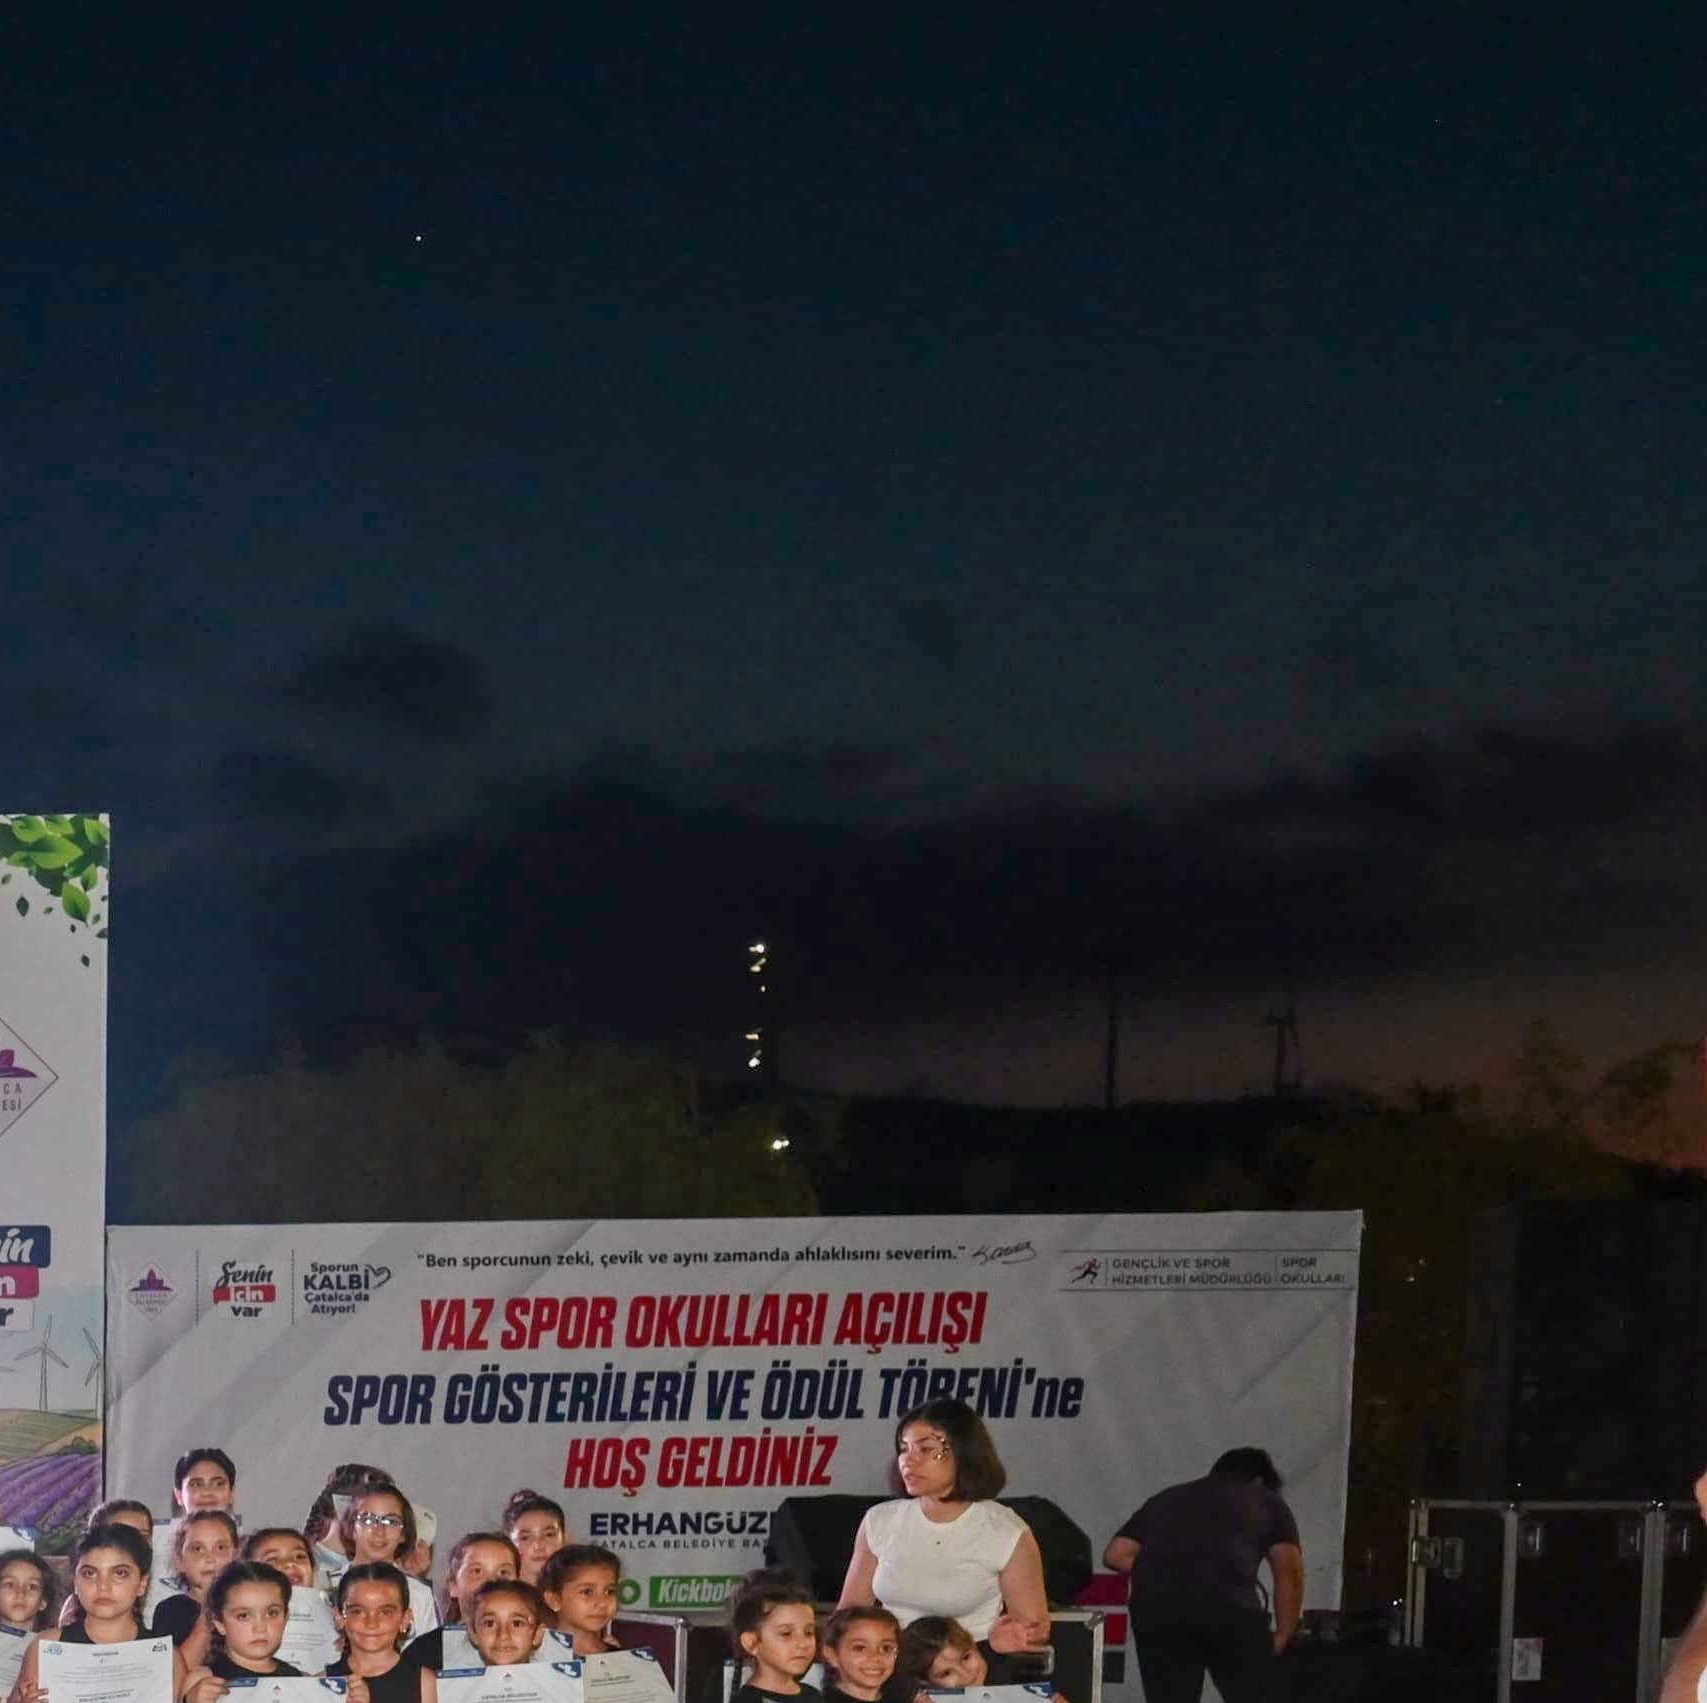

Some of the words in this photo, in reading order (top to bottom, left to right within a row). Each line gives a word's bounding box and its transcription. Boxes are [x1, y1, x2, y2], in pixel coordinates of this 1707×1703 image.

[462, 1252, 552, 1269] sporcunun
[556, 1250, 594, 1268] zeki,
[600, 1250, 642, 1268] çevik
[648, 1253, 668, 1266] ve
[673, 1252, 709, 1268] aynı
[713, 1248, 790, 1265] zamanda
[794, 1247, 881, 1264] ahlaklısını
[1111, 1256, 1170, 1270] GENÇLİK
[1174, 1257, 1191, 1269] VE
[1194, 1257, 1232, 1269] SPOR
[1281, 1257, 1318, 1269] SPOR
[215, 1258, 275, 1289] Senin
[310, 1261, 359, 1275] Sporun
[303, 1268, 370, 1291] KALBİ
[1111, 1272, 1187, 1286] HİZMETLERİ
[1281, 1272, 1346, 1285] OKULLARI
[304, 1291, 370, 1305] Çatalca'da
[231, 1305, 263, 1318] var
[310, 1303, 356, 1317] Atıyor!
[419, 1298, 494, 1351] YAZ
[500, 1296, 617, 1350] SPOR
[626, 1293, 828, 1348] OKULLARI
[836, 1291, 989, 1354] AÇILIŞI
[323, 1374, 437, 1426] SPOR
[443, 1361, 698, 1424] GÖSTERİLERİ
[707, 1368, 749, 1421] VE
[761, 1359, 866, 1421] ÖDÜL
[878, 1357, 1085, 1420] TÖRENİ'ne
[563, 1437, 651, 1497] HOŞ
[657, 1426, 838, 1488] GELDİNİZ
[663, 1537, 735, 1550] BELEDİYE
